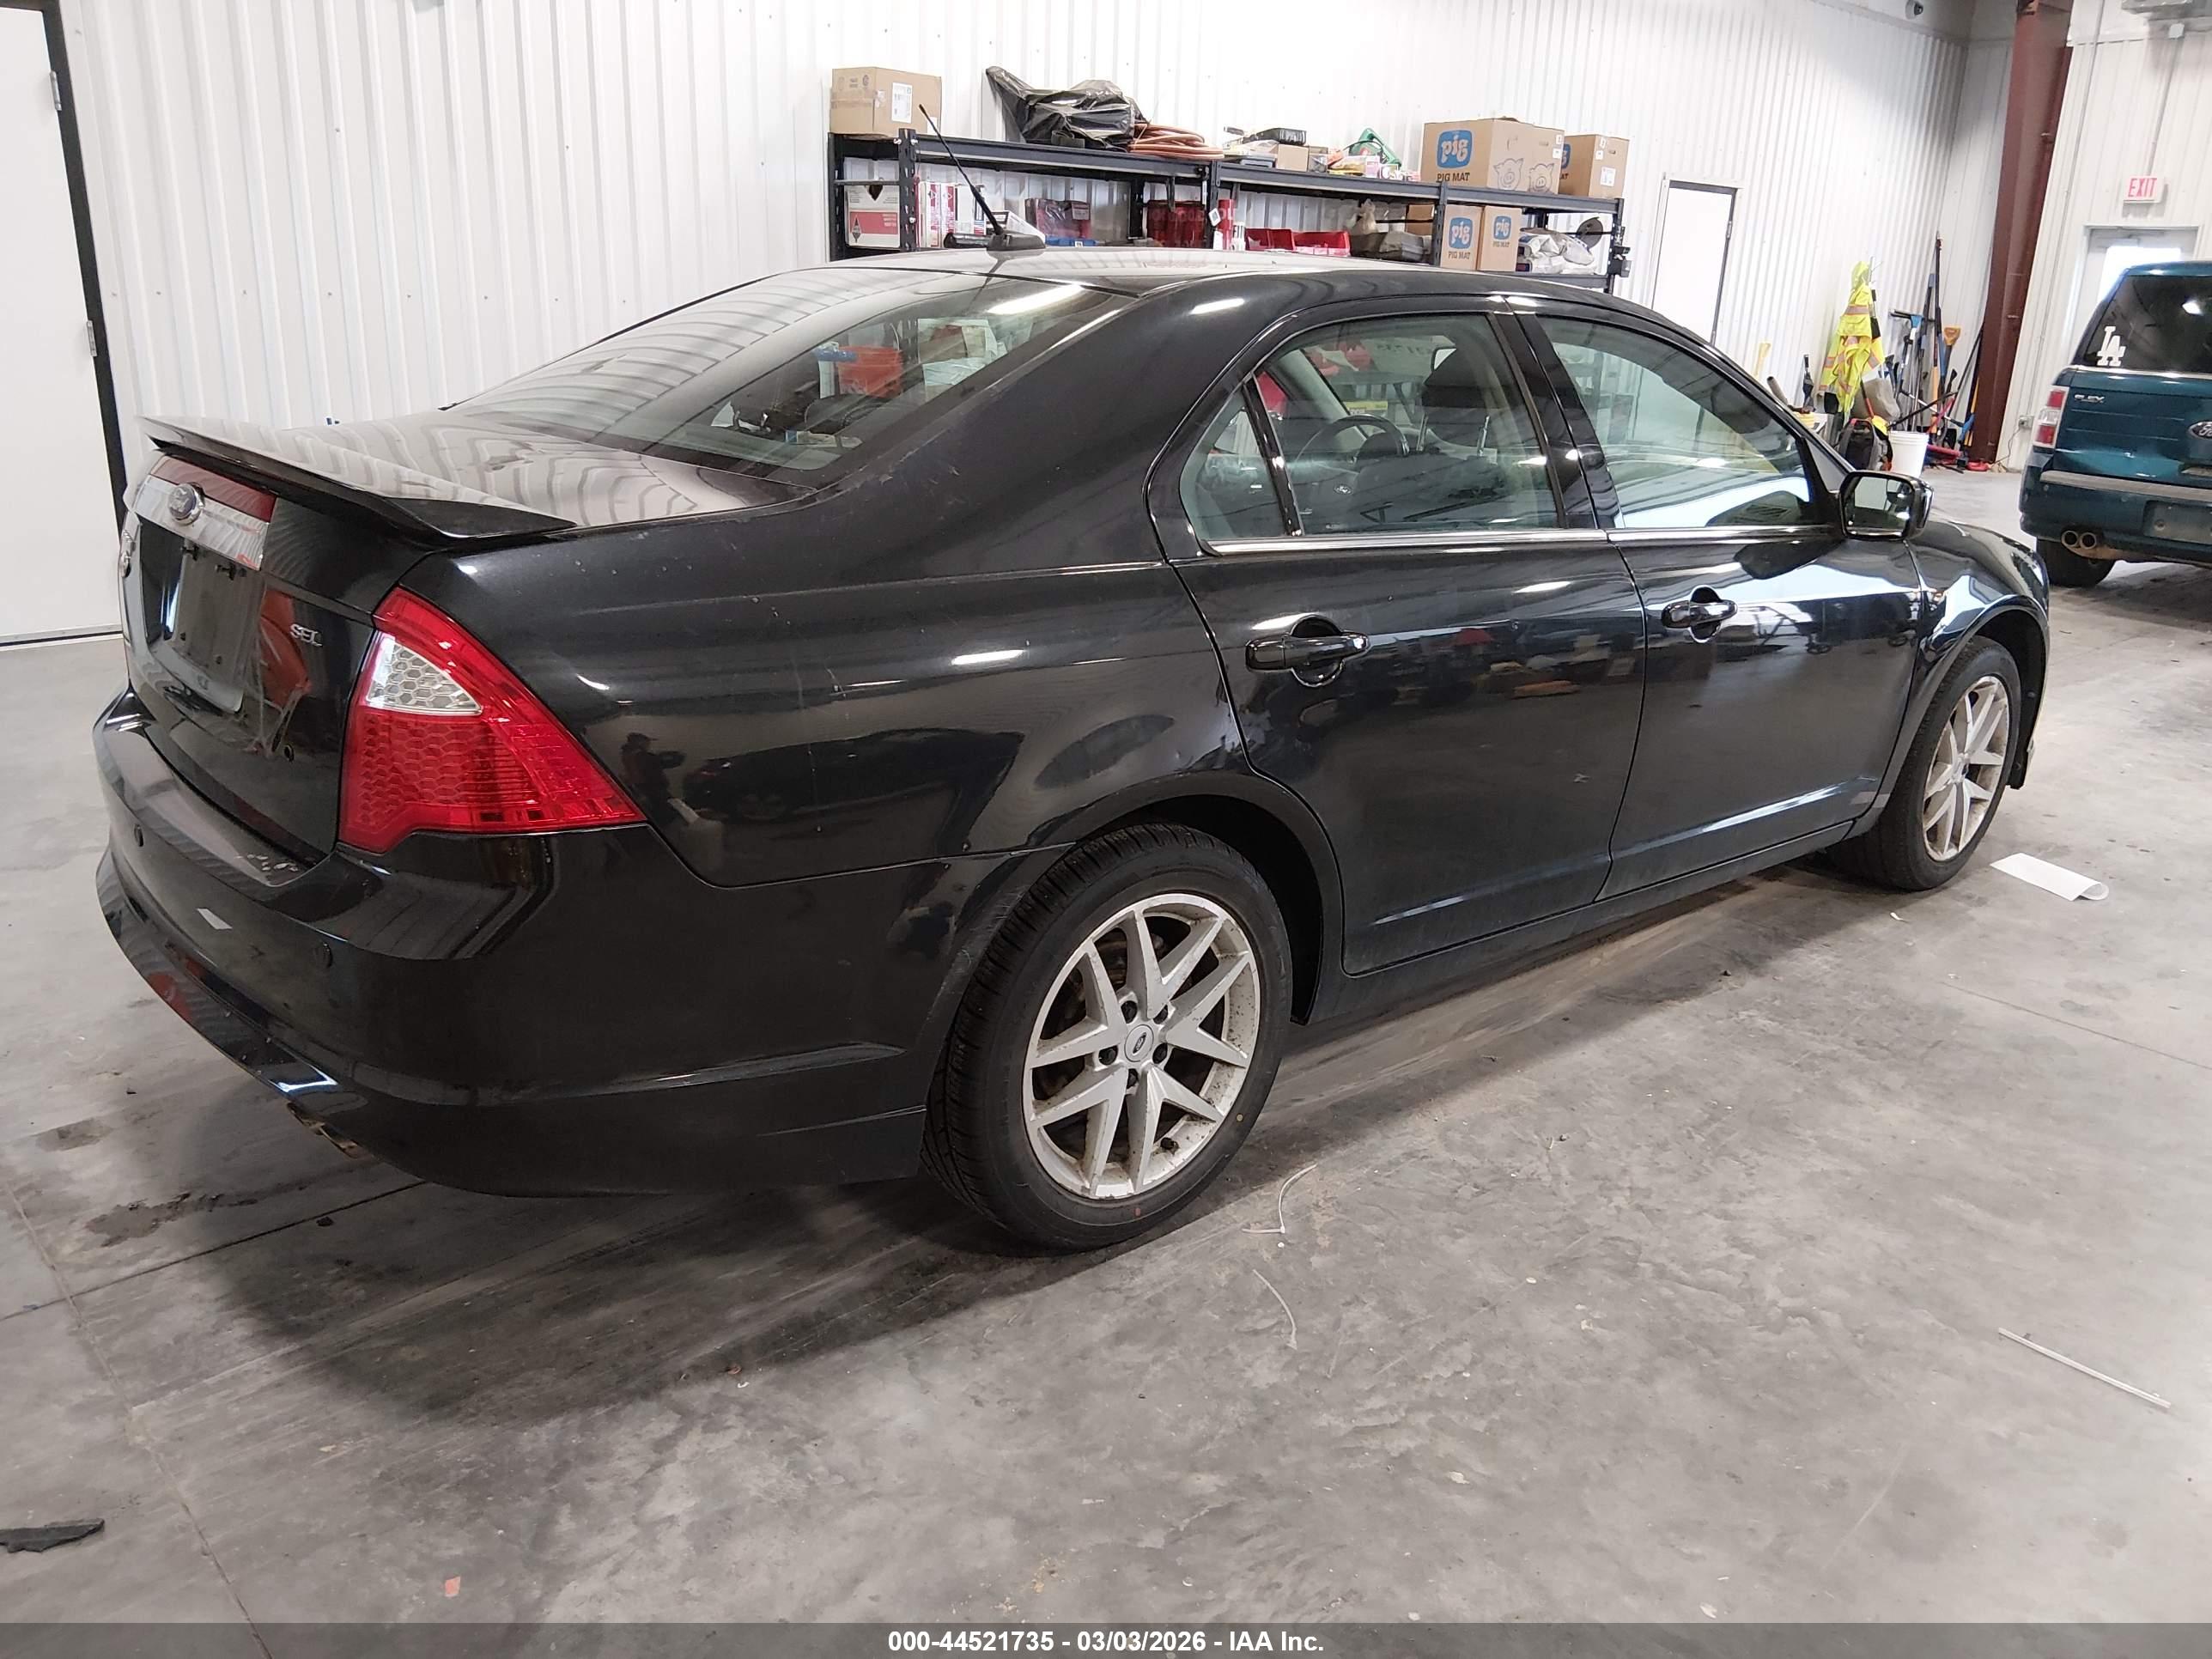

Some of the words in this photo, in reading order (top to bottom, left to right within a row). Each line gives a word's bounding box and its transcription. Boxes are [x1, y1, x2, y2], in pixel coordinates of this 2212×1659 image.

[1441, 134, 1469, 164] pig
[1437, 173, 1451, 183] PIG
[1452, 172, 1470, 182] MAT
[2128, 177, 2158, 198] EXIT
[1450, 221, 1470, 245] pig
[1495, 218, 1510, 236] pig
[1448, 251, 1458, 259] PIG
[1458, 251, 1470, 260] MAT
[289, 623, 323, 647] SEL
